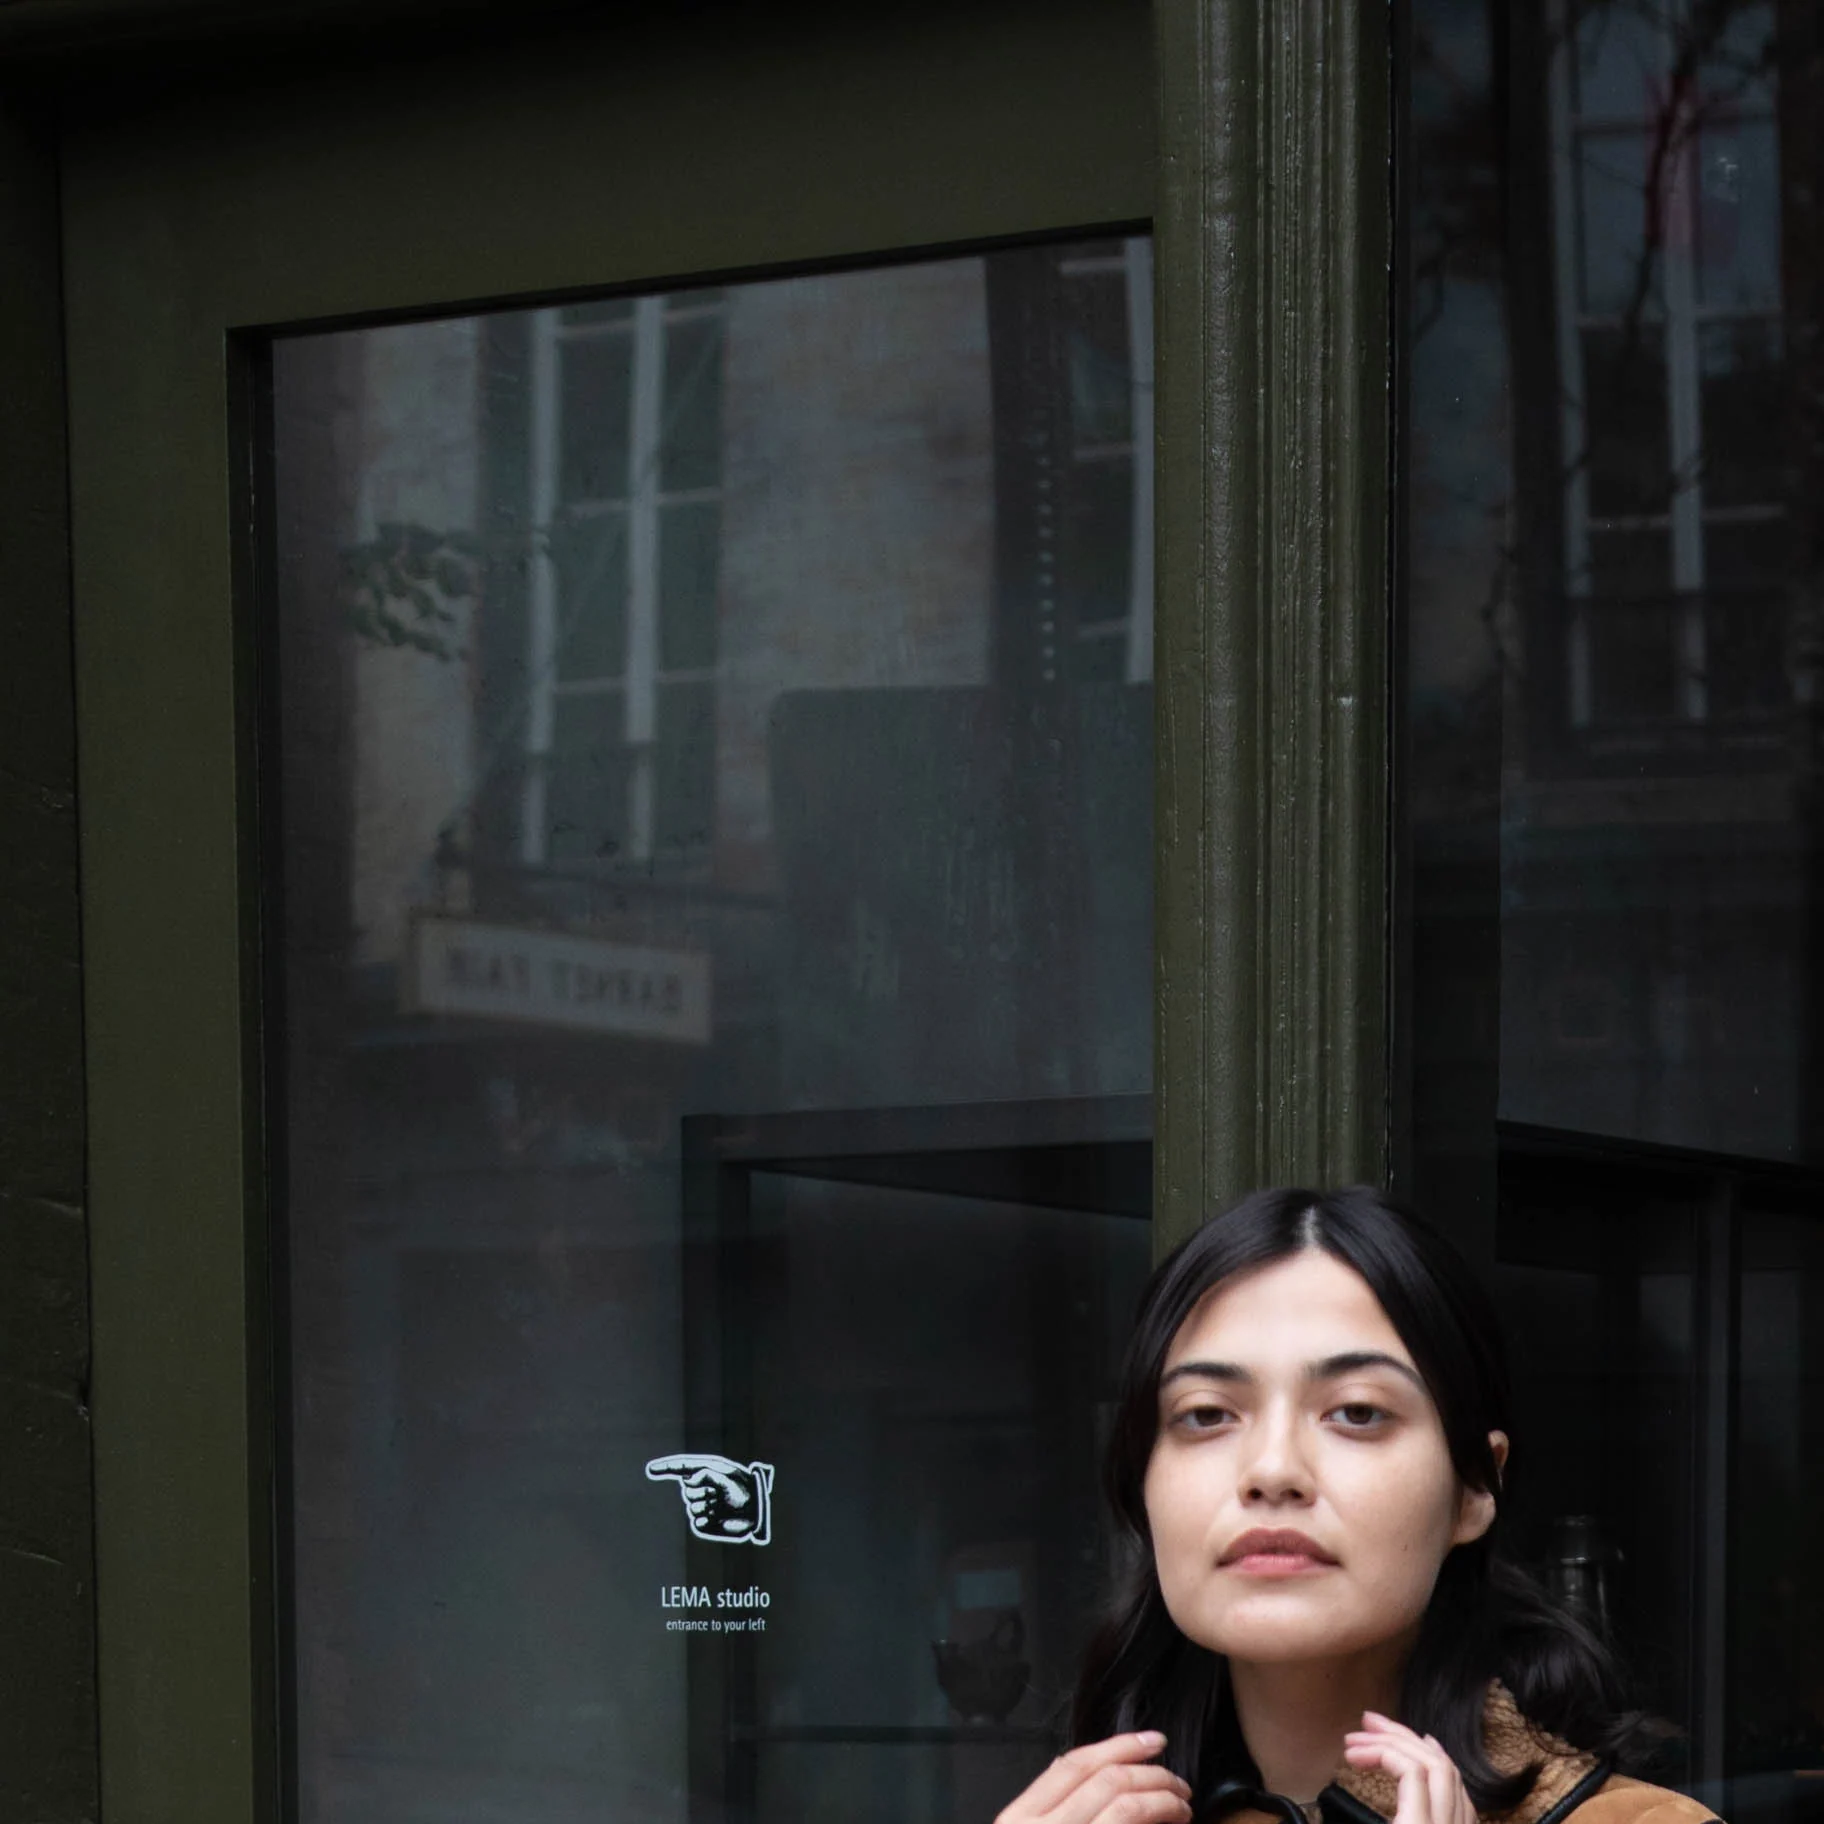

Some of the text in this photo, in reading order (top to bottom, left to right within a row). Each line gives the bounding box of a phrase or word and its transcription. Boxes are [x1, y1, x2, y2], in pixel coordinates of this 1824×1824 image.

[661, 1586, 770, 1608] LEMA studio
[666, 1618, 765, 1634] entrance to your left
